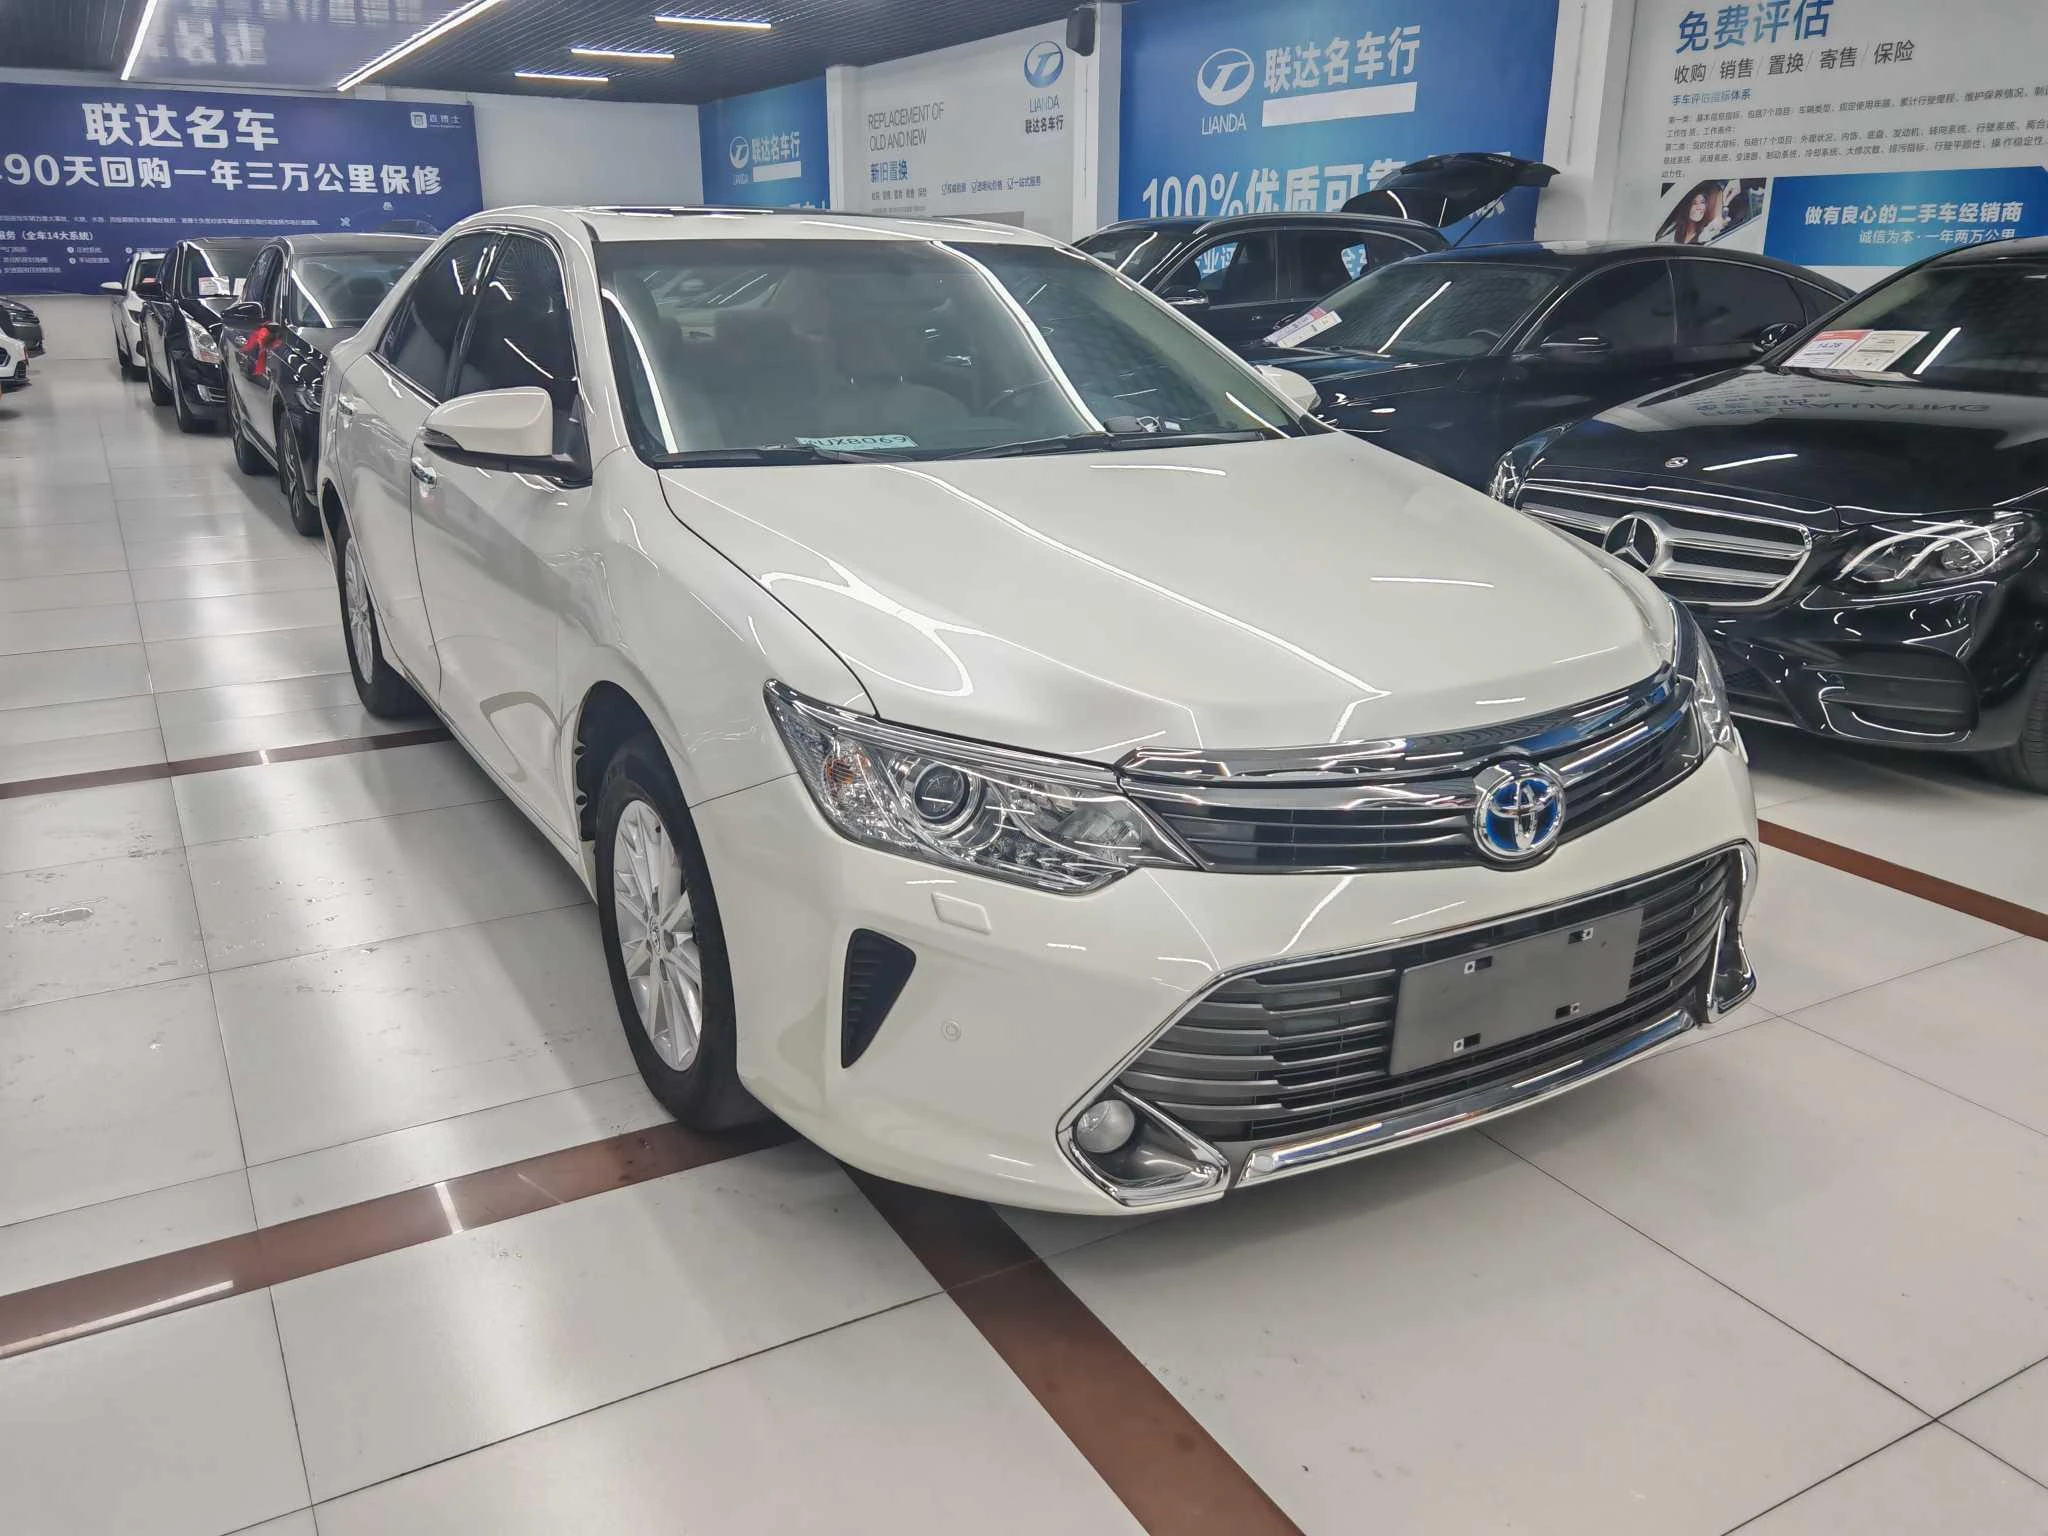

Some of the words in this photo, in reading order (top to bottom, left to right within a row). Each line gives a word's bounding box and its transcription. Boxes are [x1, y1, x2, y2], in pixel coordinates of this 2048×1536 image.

[1676, 0, 1834, 54] 免费评估
[1263, 24, 1421, 95] 联达名车行
[1674, 63, 1707, 85] 收购
[1719, 57, 1754, 81] 销售
[1768, 53, 1805, 76] 置换
[1819, 46, 1859, 70] 寄售
[1874, 40, 1915, 64] 保险
[82, 102, 279, 151] 联达名车
[868, 104, 931, 130] REPLACEMENT
[931, 102, 945, 121] OF
[1025, 115, 1064, 134] 联达名车行
[1201, 112, 1247, 136] LIANDA
[751, 131, 800, 164] 联达名车行
[870, 134, 886, 152] OLD
[887, 131, 906, 149] AND
[906, 129, 928, 147] NEW
[0, 153, 442, 196] 90天回购一年三万公里保修
[1805, 201, 2023, 225] 做有良心的二手车经销商
